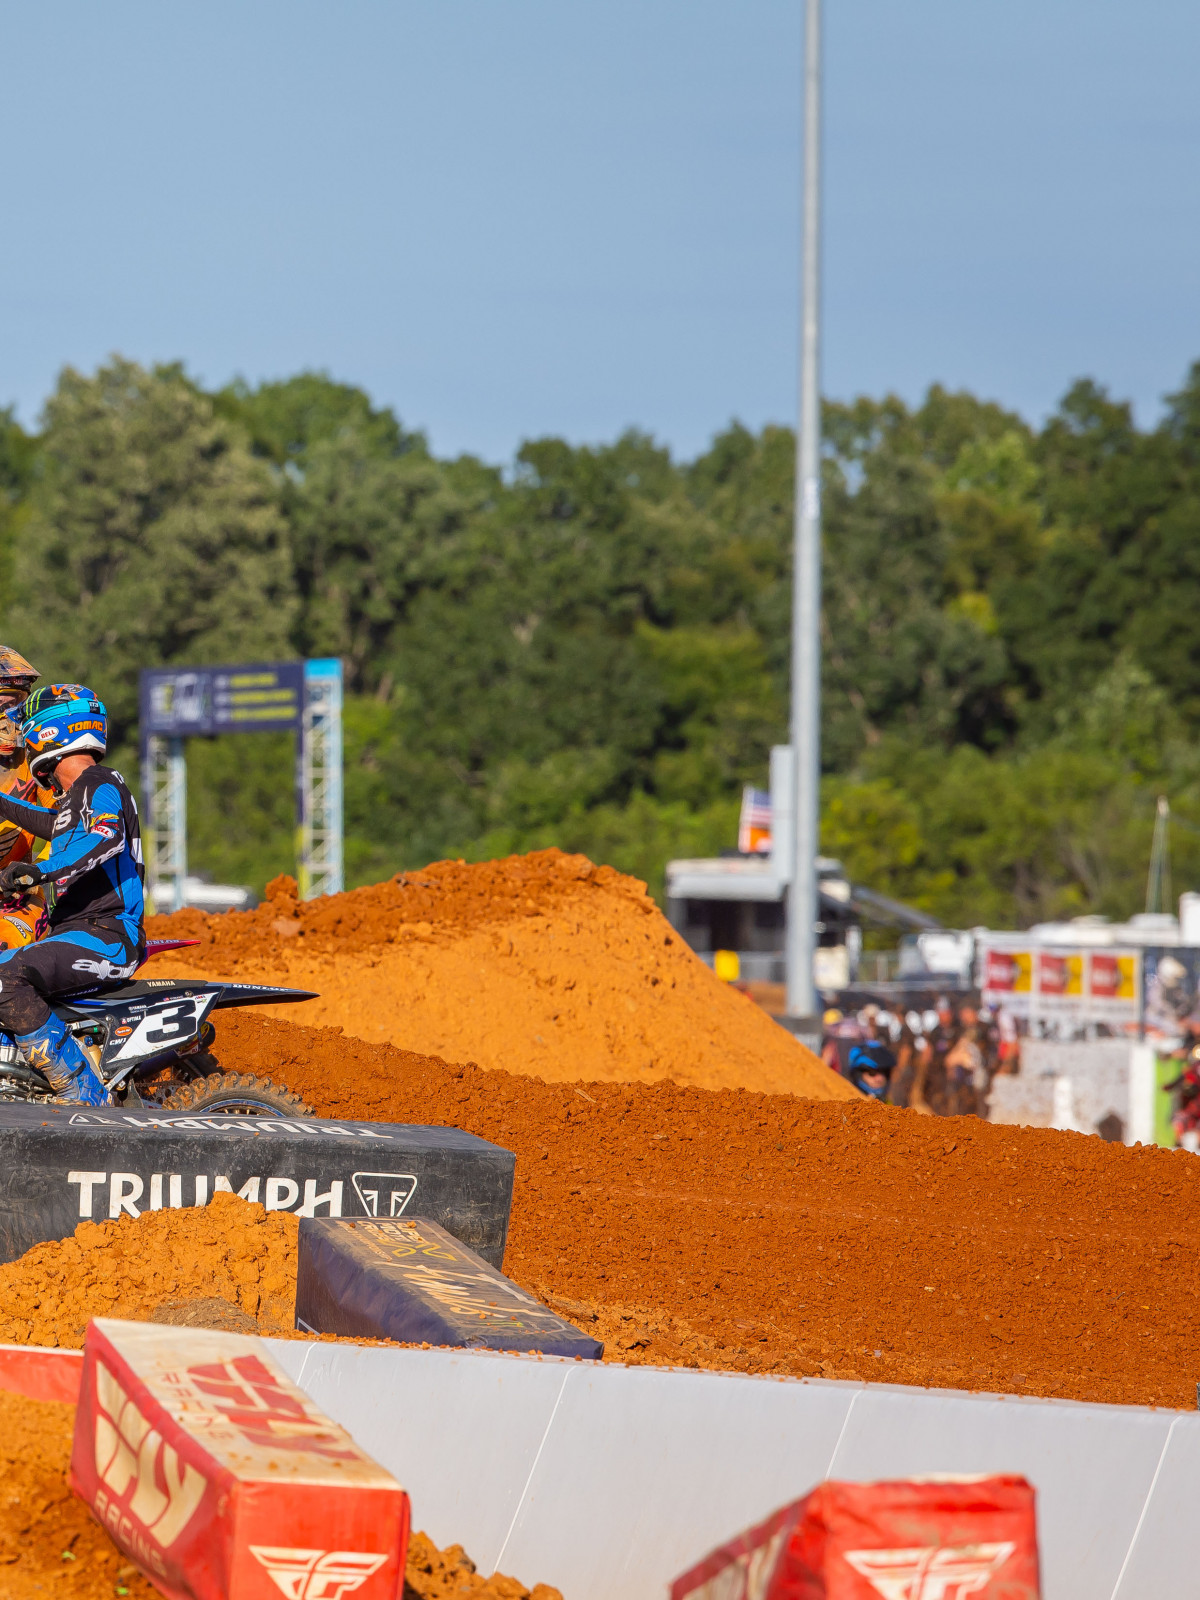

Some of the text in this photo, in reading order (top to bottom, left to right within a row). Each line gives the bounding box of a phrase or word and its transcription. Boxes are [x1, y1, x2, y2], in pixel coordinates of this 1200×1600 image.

[67, 720, 103, 734] TOMAC
[40, 730, 55, 739] BELL
[147, 980, 176, 988] YAMAHA
[232, 983, 290, 992] DUNLOP
[145, 1000, 198, 1044] 3
[96, 1360, 208, 1549] FLY
[95, 1489, 167, 1578] RACING
